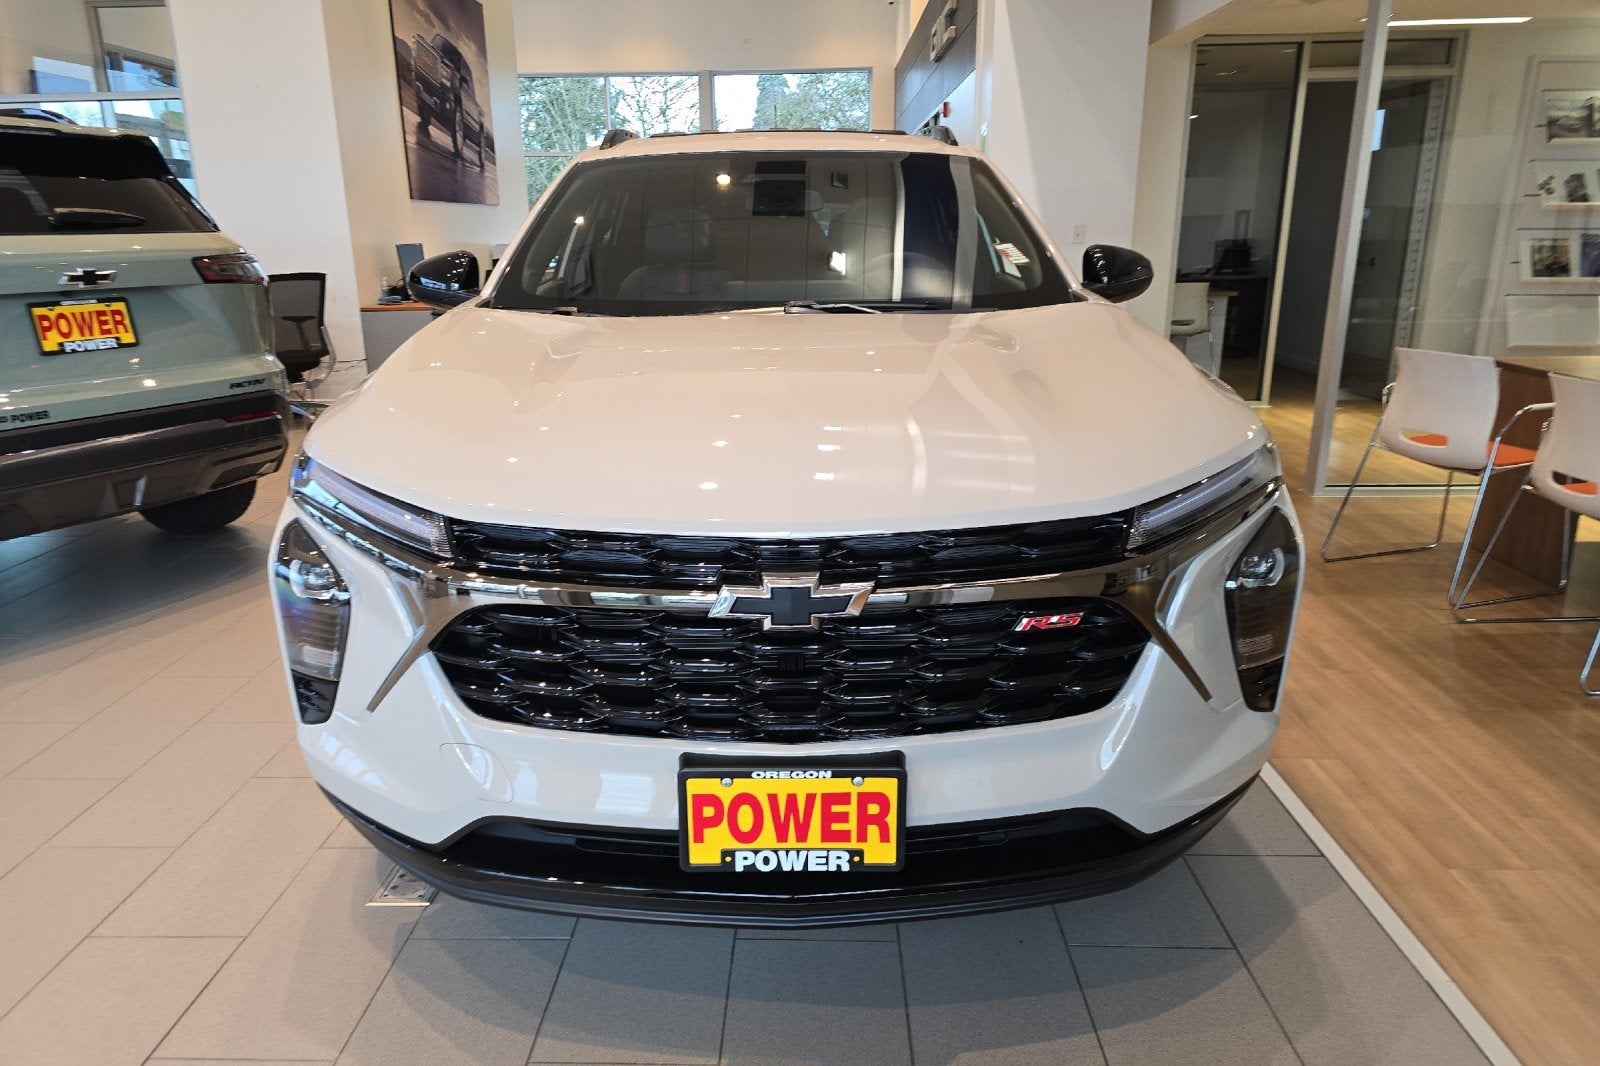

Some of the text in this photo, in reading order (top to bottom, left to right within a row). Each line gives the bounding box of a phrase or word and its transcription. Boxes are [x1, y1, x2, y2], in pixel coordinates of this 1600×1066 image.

[37, 309, 129, 341] POWER
[63, 338, 119, 353] POWER
[1014, 612, 1083, 631] RS
[751, 770, 832, 779] OREGON
[692, 792, 891, 844] POWER
[734, 850, 850, 872] POWER
